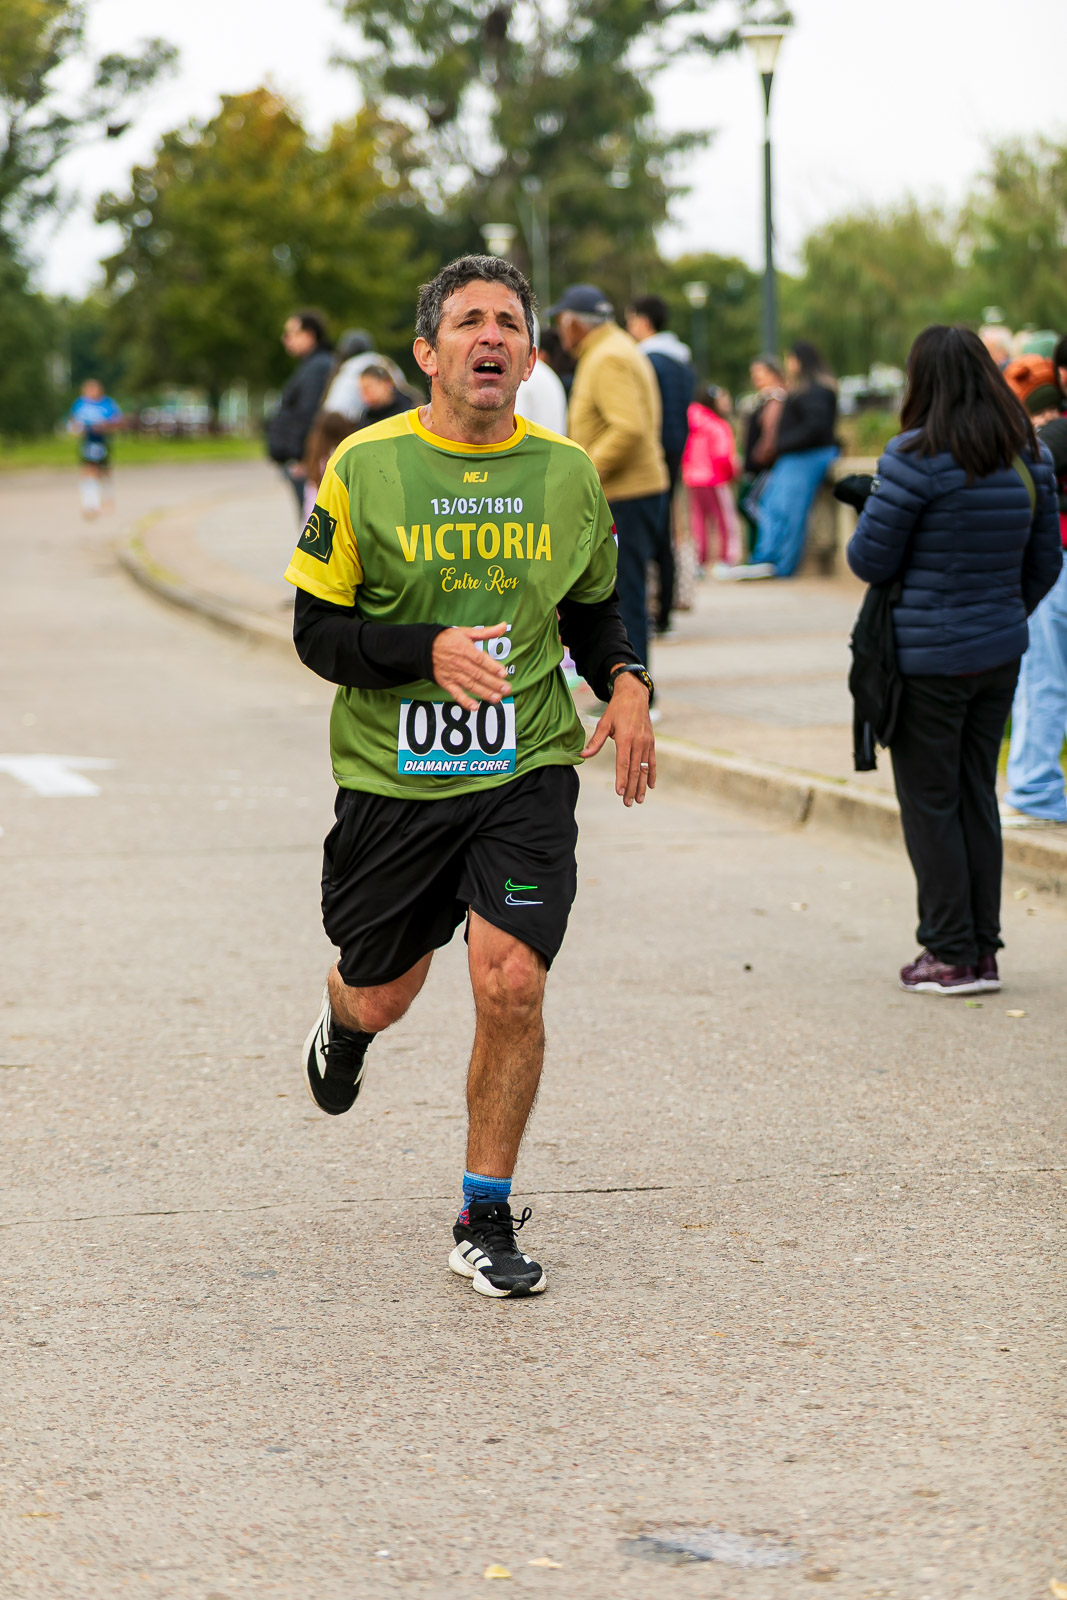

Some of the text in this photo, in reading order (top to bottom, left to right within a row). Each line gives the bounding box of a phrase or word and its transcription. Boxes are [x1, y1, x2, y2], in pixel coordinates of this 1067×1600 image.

[463, 471, 489, 483] NEJ
[430, 497, 524, 516] 13/05/1810
[395, 522, 552, 563] VICTORIA
[439, 566, 482, 593] Entre
[406, 699, 506, 756] 080
[403, 760, 511, 772] DIAMANTE CORRE
